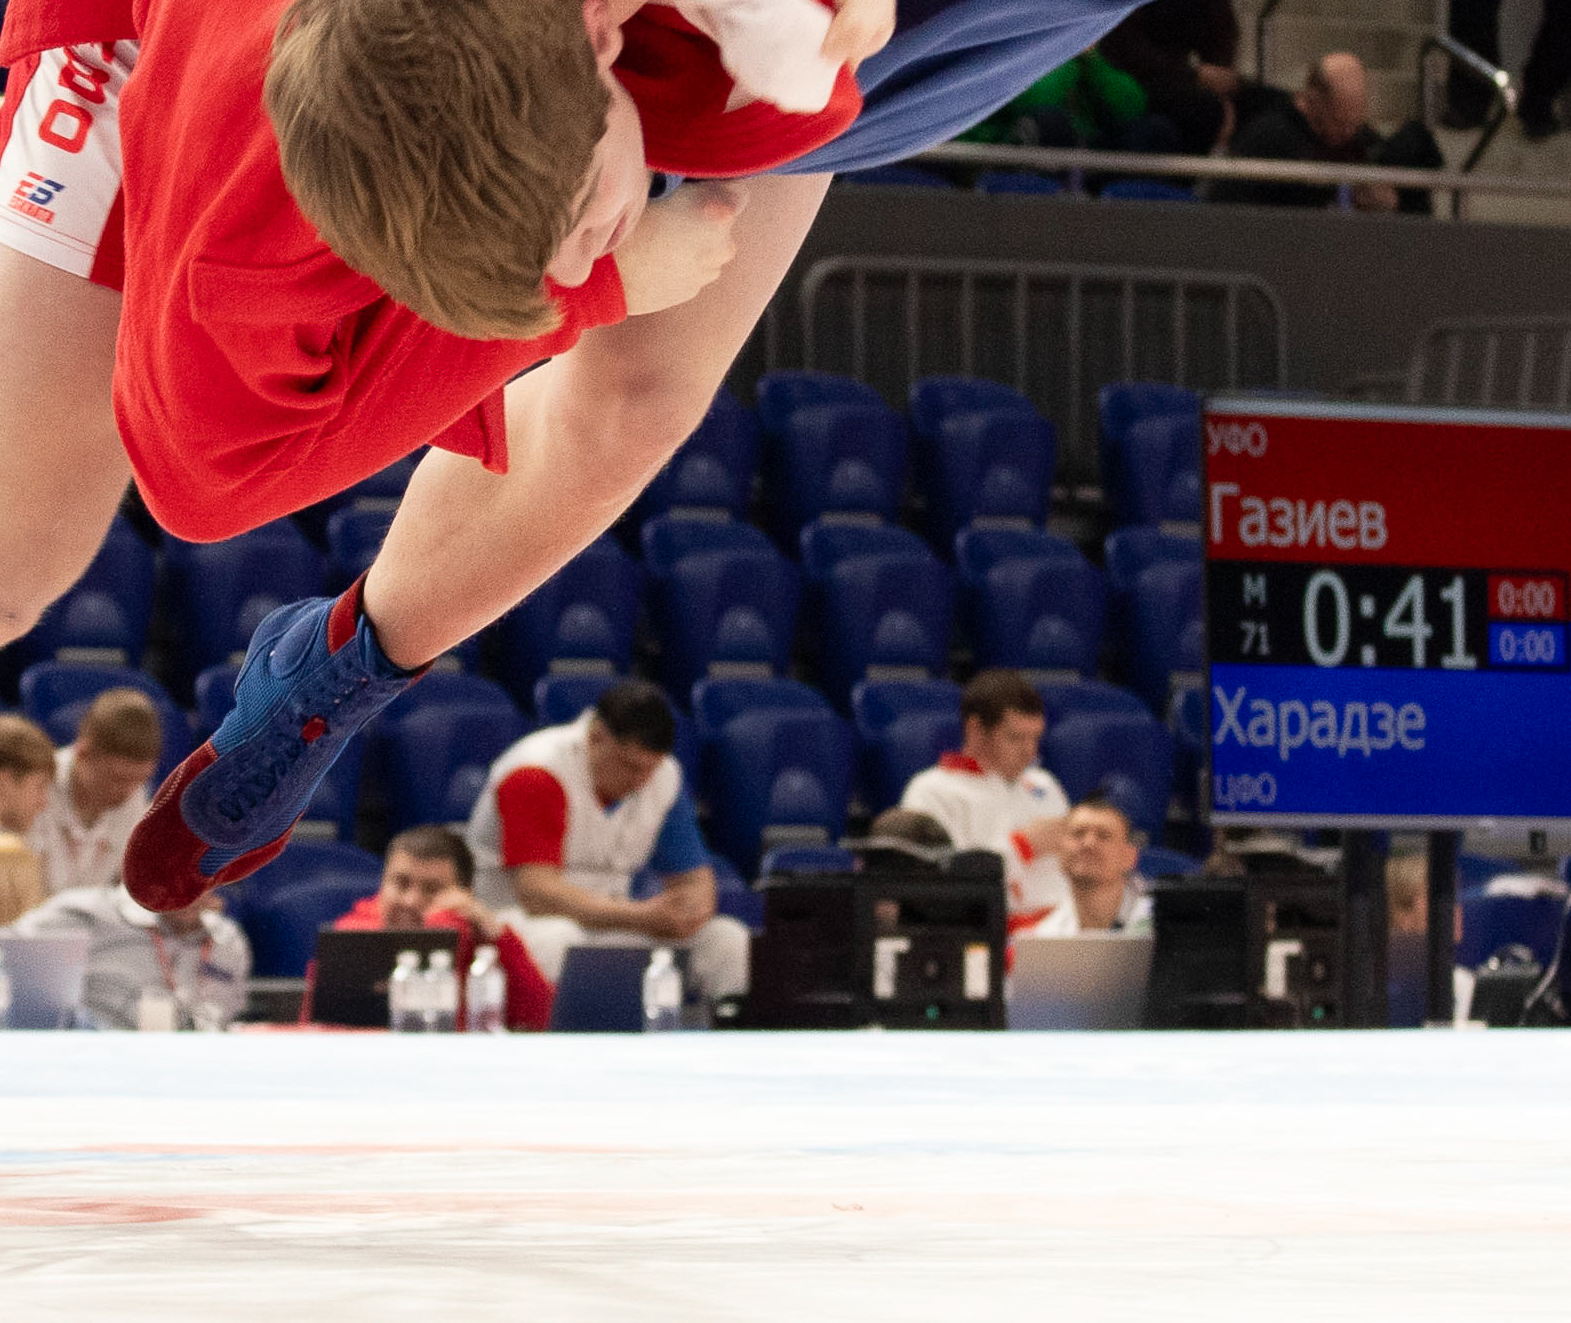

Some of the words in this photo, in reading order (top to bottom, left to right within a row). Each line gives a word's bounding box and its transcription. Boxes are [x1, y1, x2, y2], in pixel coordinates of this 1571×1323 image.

[1207, 422, 1268, 457] УФО
[1210, 482, 1388, 550] Газиев
[1498, 580, 1556, 617] 0:00
[1240, 620, 1271, 656] 71
[1302, 569, 1478, 671] 0:41
[1498, 629, 1556, 663] 0:00
[1213, 685, 1426, 761] Харадзе
[1214, 771, 1278, 810] ЦФО
